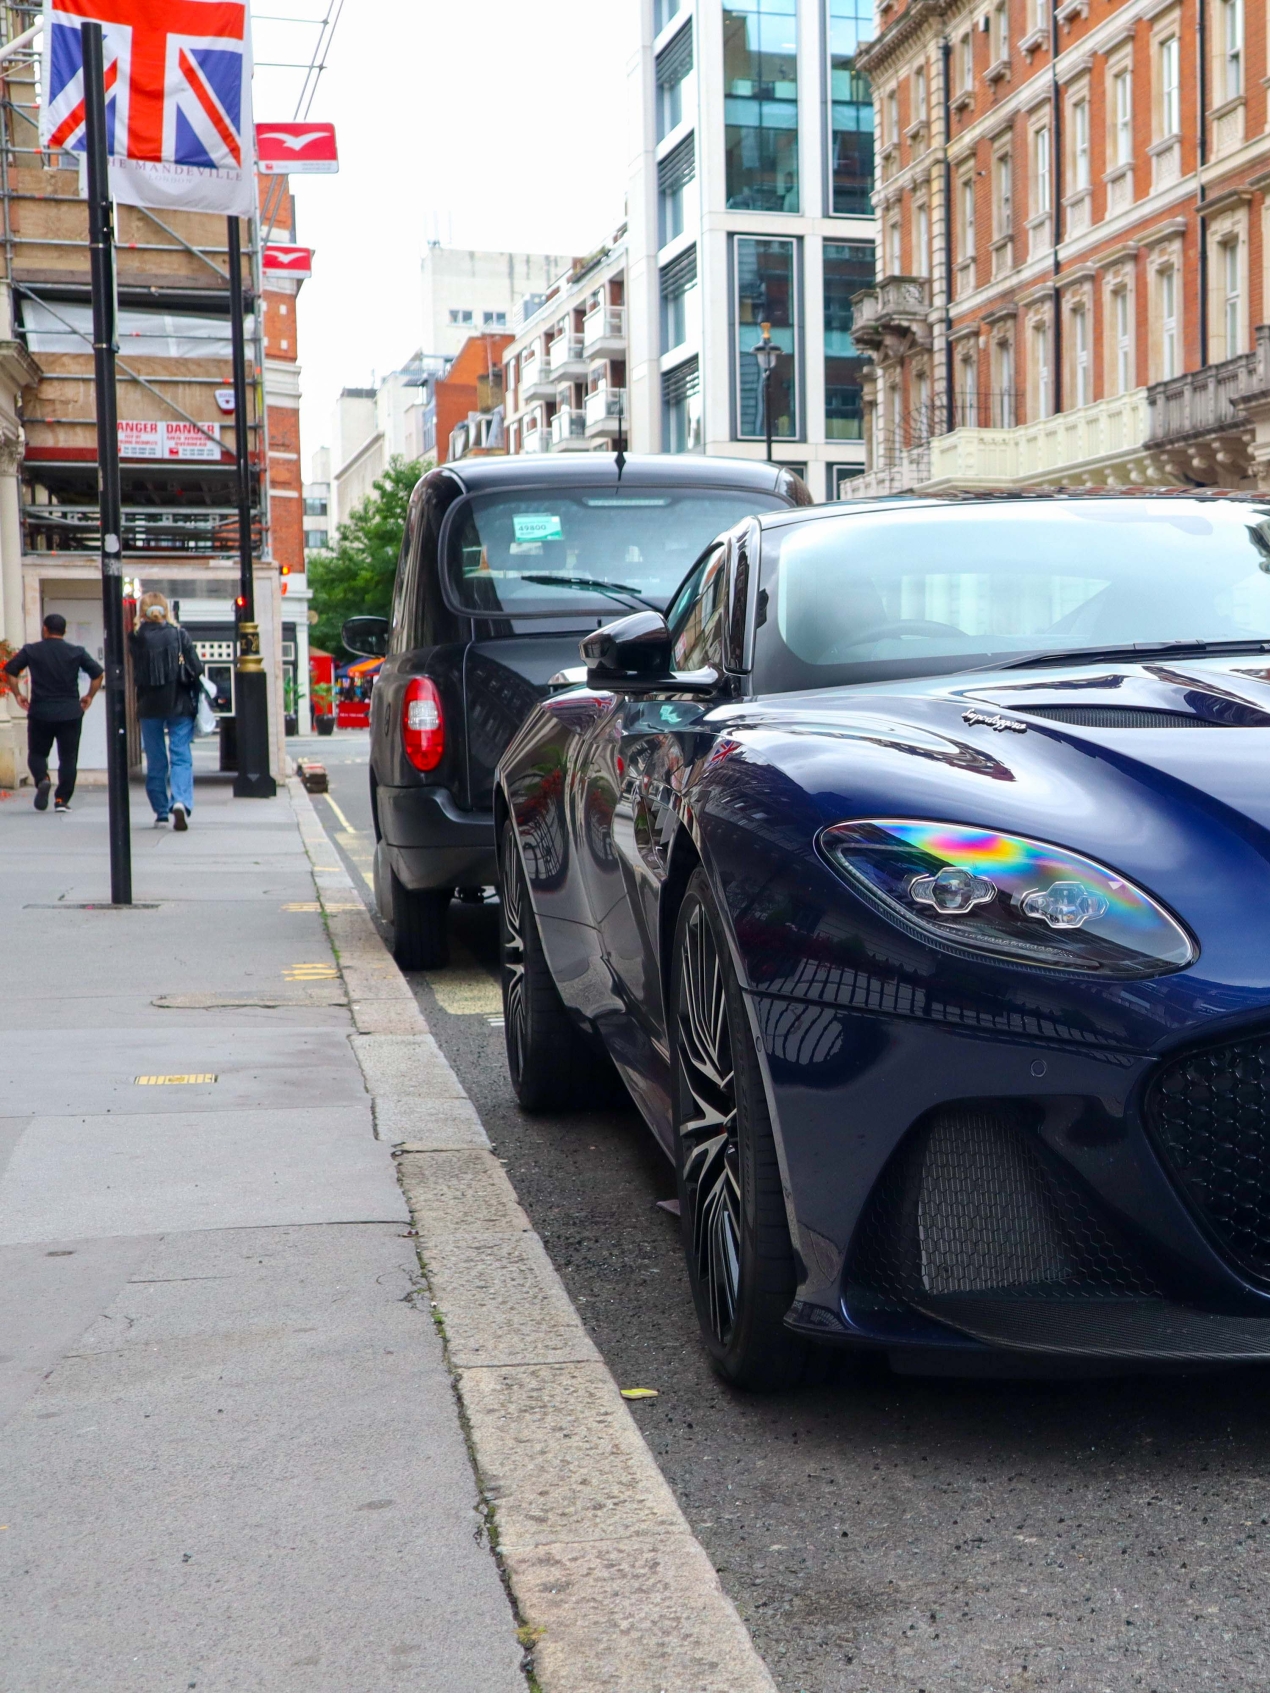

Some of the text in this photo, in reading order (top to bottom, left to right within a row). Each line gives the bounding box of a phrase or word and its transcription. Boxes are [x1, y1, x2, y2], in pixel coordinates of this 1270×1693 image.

[107, 157, 243, 182] HE MANDEVILLE
[148, 174, 193, 185] LONDON
[116, 422, 158, 434] ANGER
